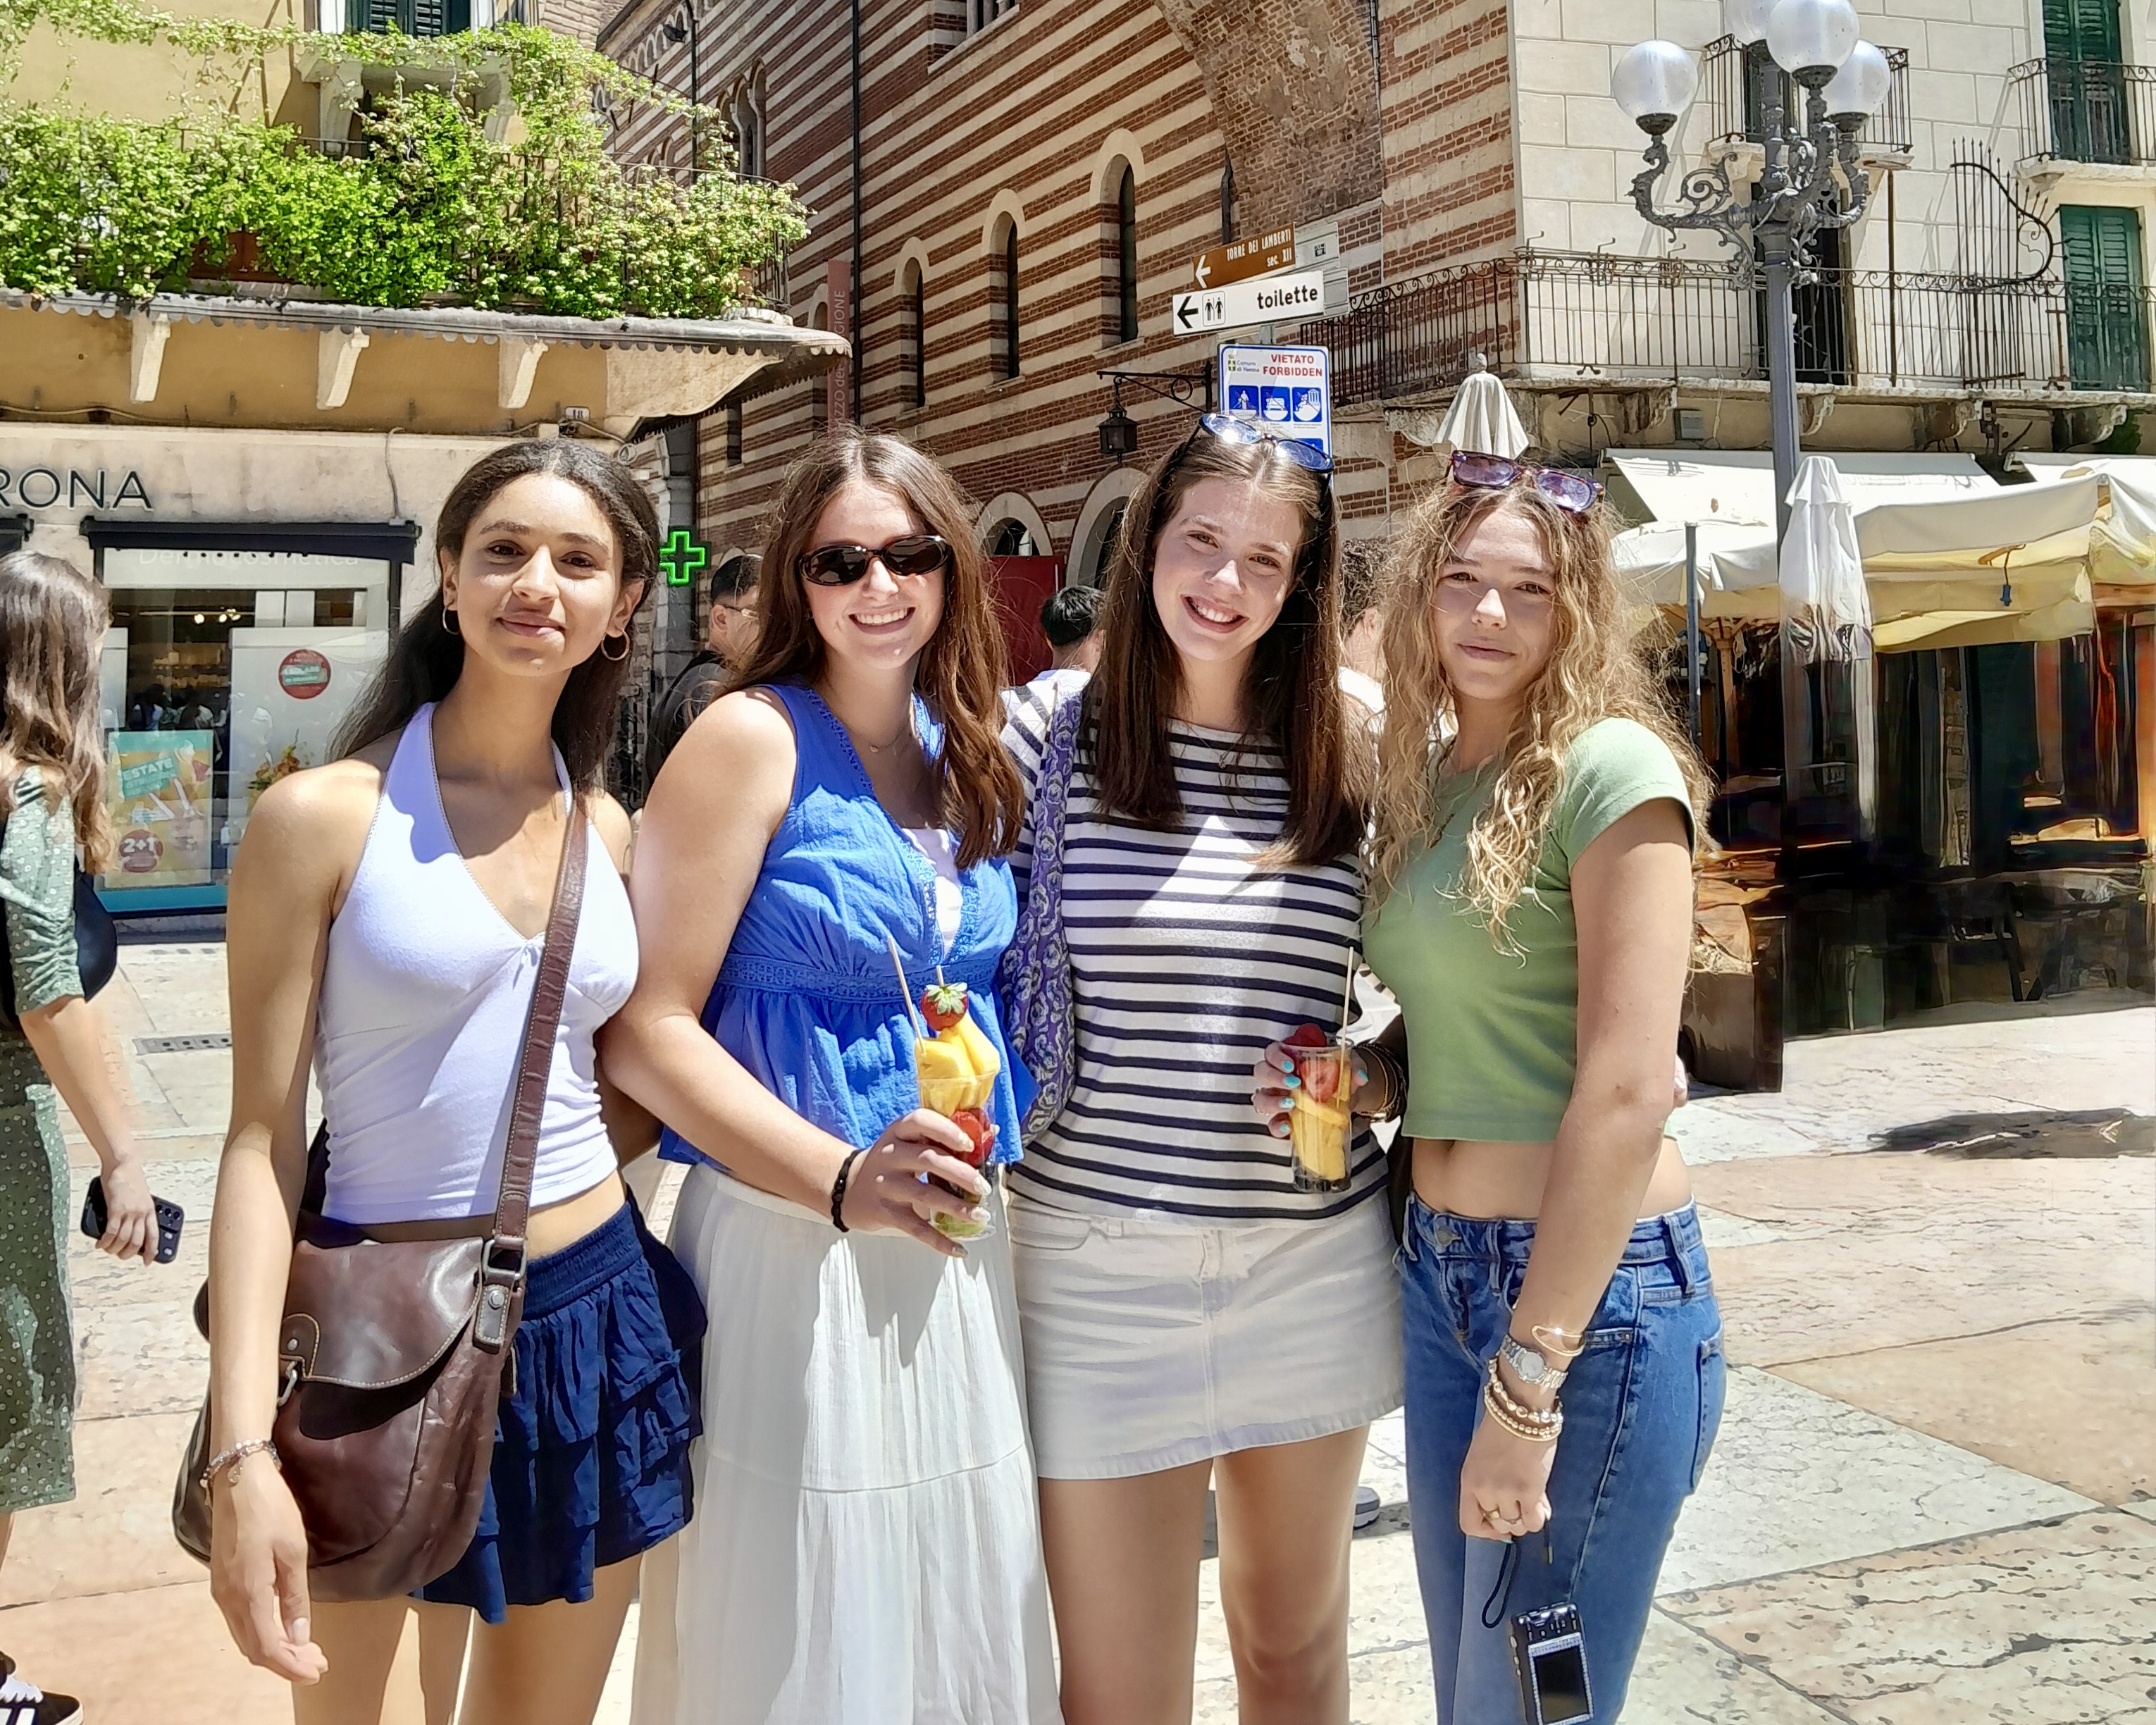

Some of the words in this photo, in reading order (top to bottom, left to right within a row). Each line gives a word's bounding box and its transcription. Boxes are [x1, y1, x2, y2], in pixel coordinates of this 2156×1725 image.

[1227, 243, 1246, 261] TORRE
[1248, 239, 1258, 254] DEI
[1261, 228, 1291, 250] LAMBERTI
[1282, 247, 1292, 263] XII
[1257, 284, 1318, 309] toilette
[834, 290, 845, 338] GIONE
[1271, 354, 1314, 364] VIETATO
[1263, 366, 1322, 377] FORBIDDEN
[123, 836, 155, 853] 2+1
